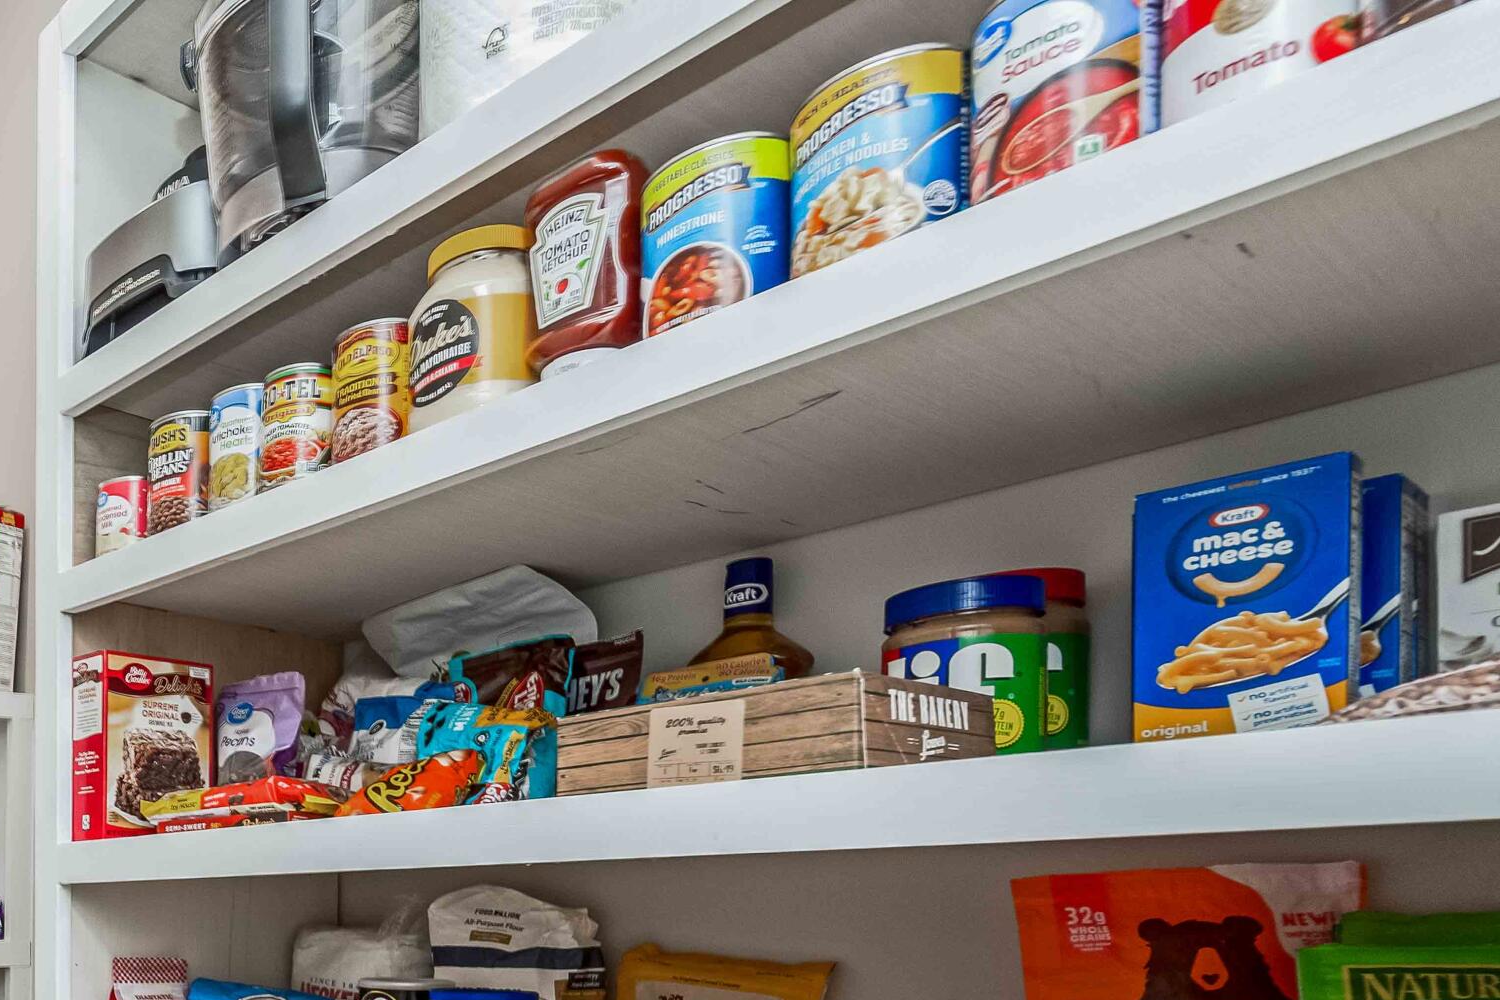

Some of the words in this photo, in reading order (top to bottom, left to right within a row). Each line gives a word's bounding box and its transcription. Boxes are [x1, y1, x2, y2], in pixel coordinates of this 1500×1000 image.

[1004, 19, 1082, 61] Tomato
[1192, 38, 1302, 94] Tomato
[797, 84, 894, 168] PROGRESSO
[807, 136, 855, 174] CHICKEN
[862, 132, 870, 143] &
[846, 138, 909, 165] NOODLES
[649, 164, 742, 231] PROGRESSO
[546, 208, 585, 238] HEINZ
[657, 210, 725, 248] MINESTRONE
[539, 228, 591, 264] TOMATO
[541, 244, 588, 275] KETCHUP
[336, 376, 392, 398] TRADITIONAL
[266, 407, 311, 422] Original
[1221, 509, 1255, 523] Kraft
[1193, 528, 1259, 553] mac
[1262, 521, 1286, 540] &
[725, 587, 757, 604] Kraft
[668, 673, 696, 681] Protein
[1249, 691, 1266, 700] no
[1268, 682, 1309, 697] artificial
[1264, 693, 1297, 704] flavors
[142, 701, 179, 712] SUPREME
[142, 710, 180, 721] ORIGINAL
[888, 689, 915, 722] THE
[919, 694, 969, 731] BAKERY
[1254, 709, 1272, 719] no
[1273, 701, 1314, 715] artificial
[698, 717, 726, 727] quality
[1253, 708, 1318, 727] preservatives
[1141, 721, 1208, 739] original
[220, 736, 256, 748] Pecans
[165, 823, 206, 832] SEMI-SWEET
[464, 918, 503, 928] All-Purpose
[505, 922, 525, 932] Flour
[1064, 906, 1107, 926] 32g
[1069, 926, 1110, 935] WHOLE
[1070, 933, 1112, 942] GRAINS
